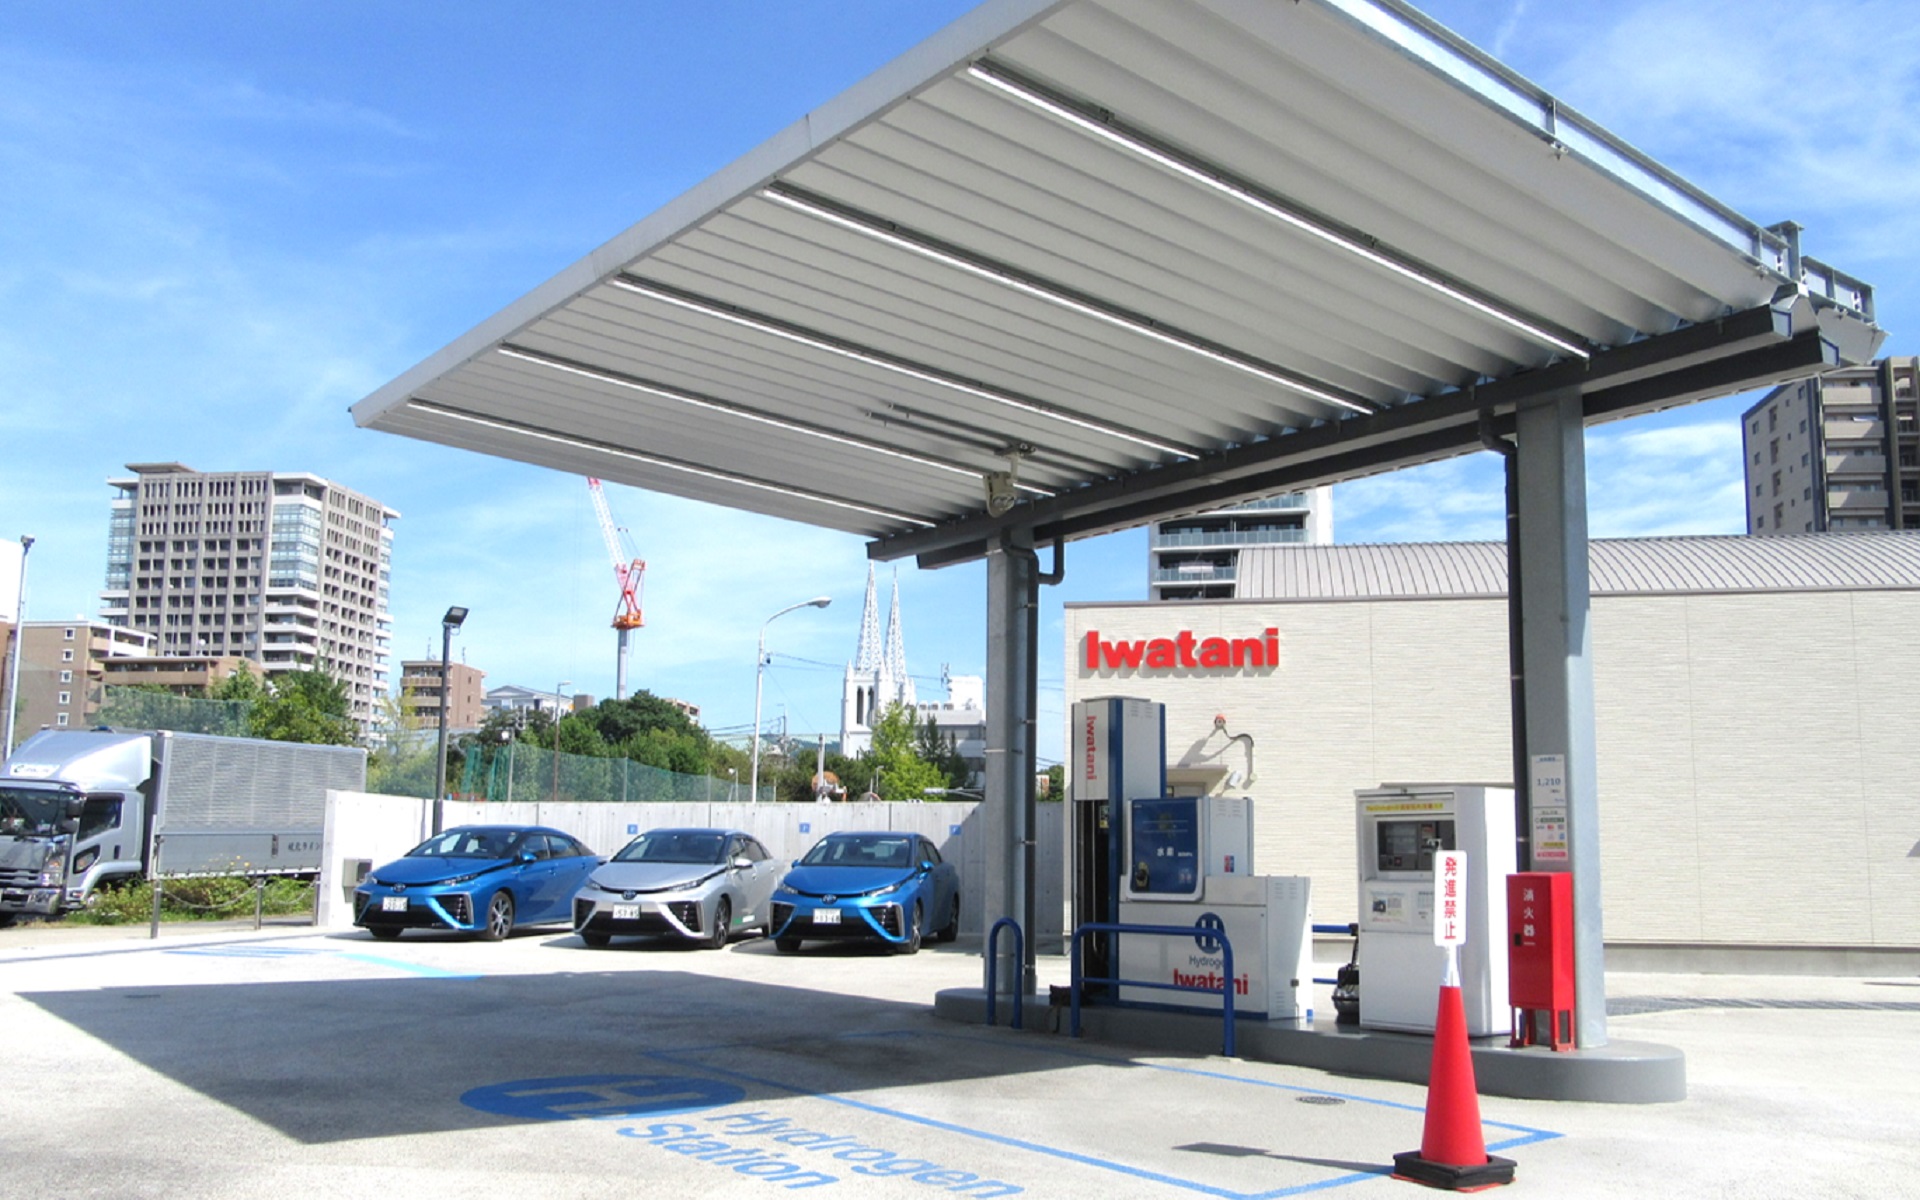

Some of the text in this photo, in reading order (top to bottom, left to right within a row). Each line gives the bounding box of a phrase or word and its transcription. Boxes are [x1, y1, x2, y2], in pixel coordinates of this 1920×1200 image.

[1086, 627, 1279, 669] Iwatani
[1086, 715, 1097, 780] Iwatani
[1536, 777, 1562, 787] 1,210
[1444, 856, 1458, 940] 発進禁止
[1523, 888, 1535, 937] 消火器
[1188, 955, 1225, 970] Hydrog
[616, 1122, 840, 1189] Station
[704, 1110, 1026, 1199] Hydrogen
